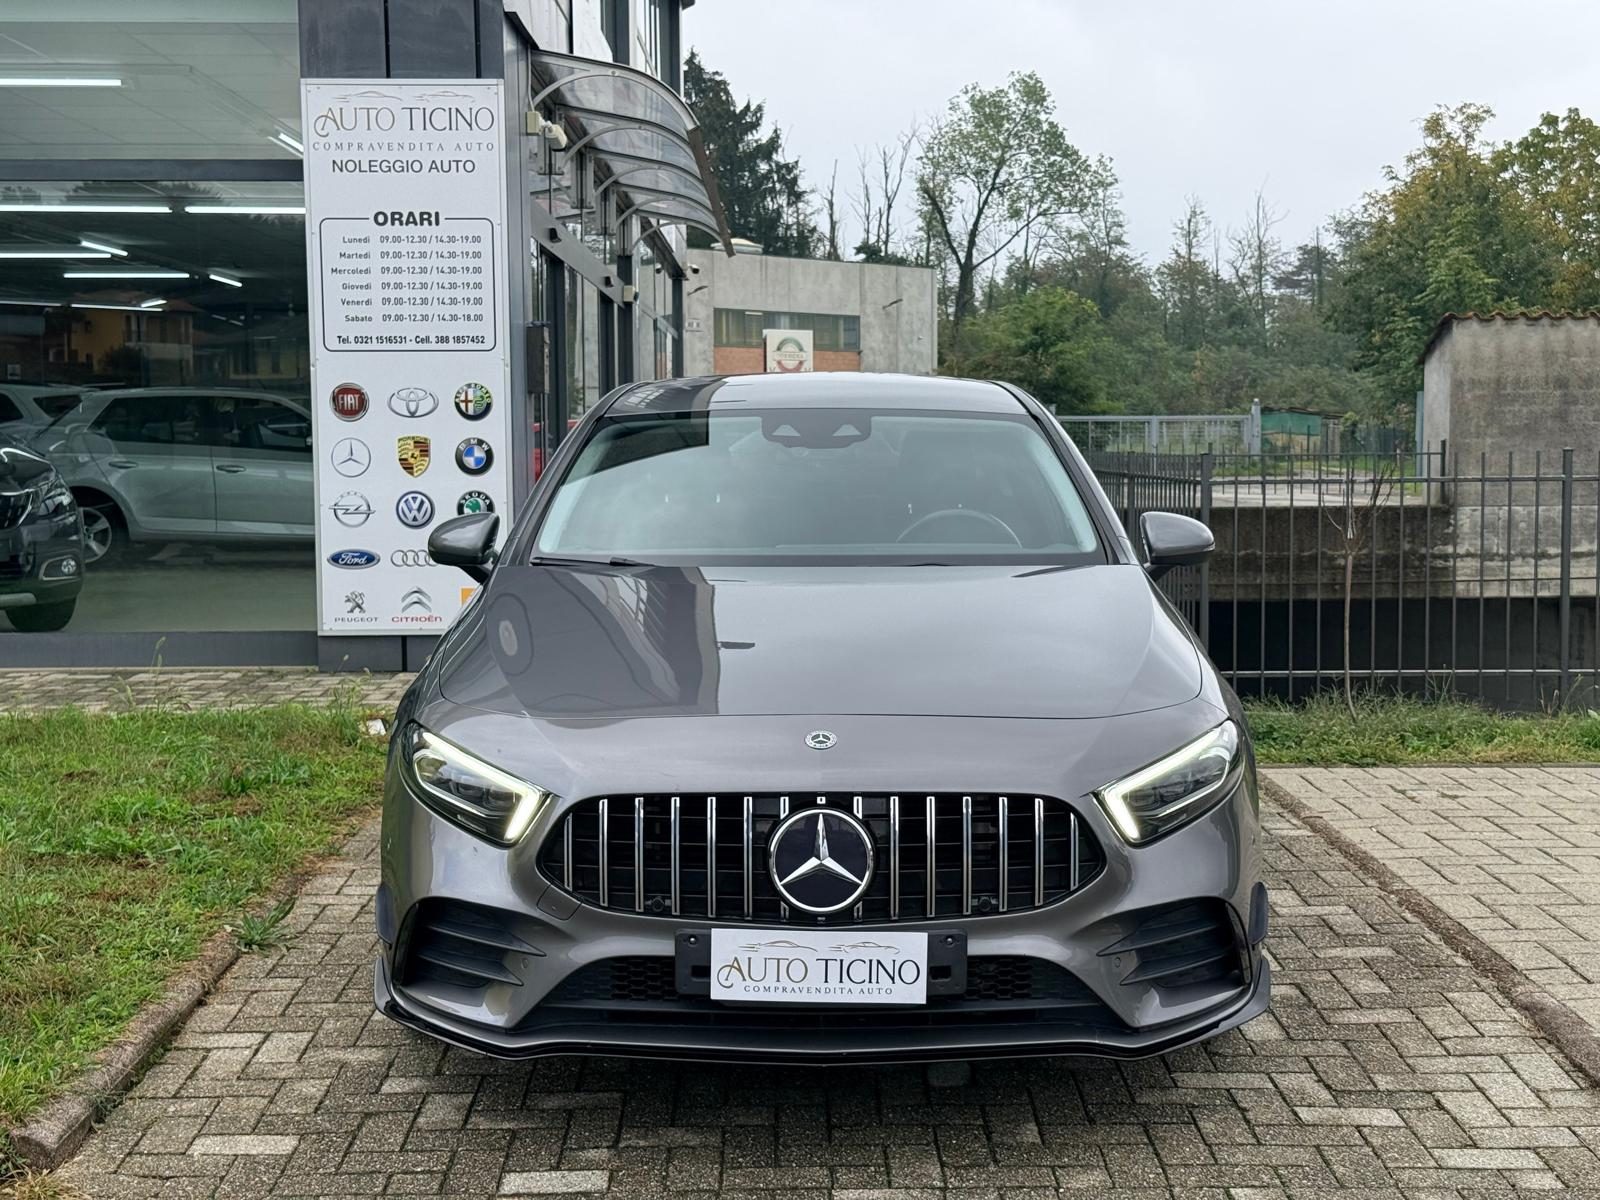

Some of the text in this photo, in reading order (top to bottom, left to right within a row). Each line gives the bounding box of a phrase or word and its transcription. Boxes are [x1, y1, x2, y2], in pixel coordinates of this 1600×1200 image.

[313, 107, 495, 138] AUTO TICINO
[312, 142, 495, 151] COMPRAVENDITA AUTO
[332, 159, 476, 173] NOLEGGIO AUTO
[373, 210, 440, 227] ORARI
[380, 235, 426, 243] 09.00-12.30
[435, 235, 481, 243] 14.30-19.00
[380, 251, 427, 259] 09.00-12.30
[436, 251, 481, 259] 14.30-19.00
[381, 266, 428, 274] 09.00-12.30
[436, 266, 482, 274] 14.30-19.00
[381, 282, 428, 290] 09.00-12.30
[436, 282, 483, 290] 14.30-19.00
[382, 298, 428, 306] 09.00-12.30
[437, 298, 483, 306] 14.30-19.00
[345, 314, 373, 322] Sabato
[382, 314, 429, 322] 09.00-12.30
[437, 314, 483, 322] 14.30-18.00
[337, 336, 351, 344] Tel.
[354, 335, 373, 344] 0321
[375, 335, 407, 344] 1516531
[415, 335, 432, 344] Cell.
[435, 335, 449, 344] 388
[452, 335, 485, 344] 1857452
[338, 393, 360, 411] FIAT
[458, 438, 490, 451] BMW
[338, 552, 367, 565] Ford
[716, 956, 921, 989] AUTO TICINO
[744, 985, 894, 995] COMPRAVENDITA AUTO
